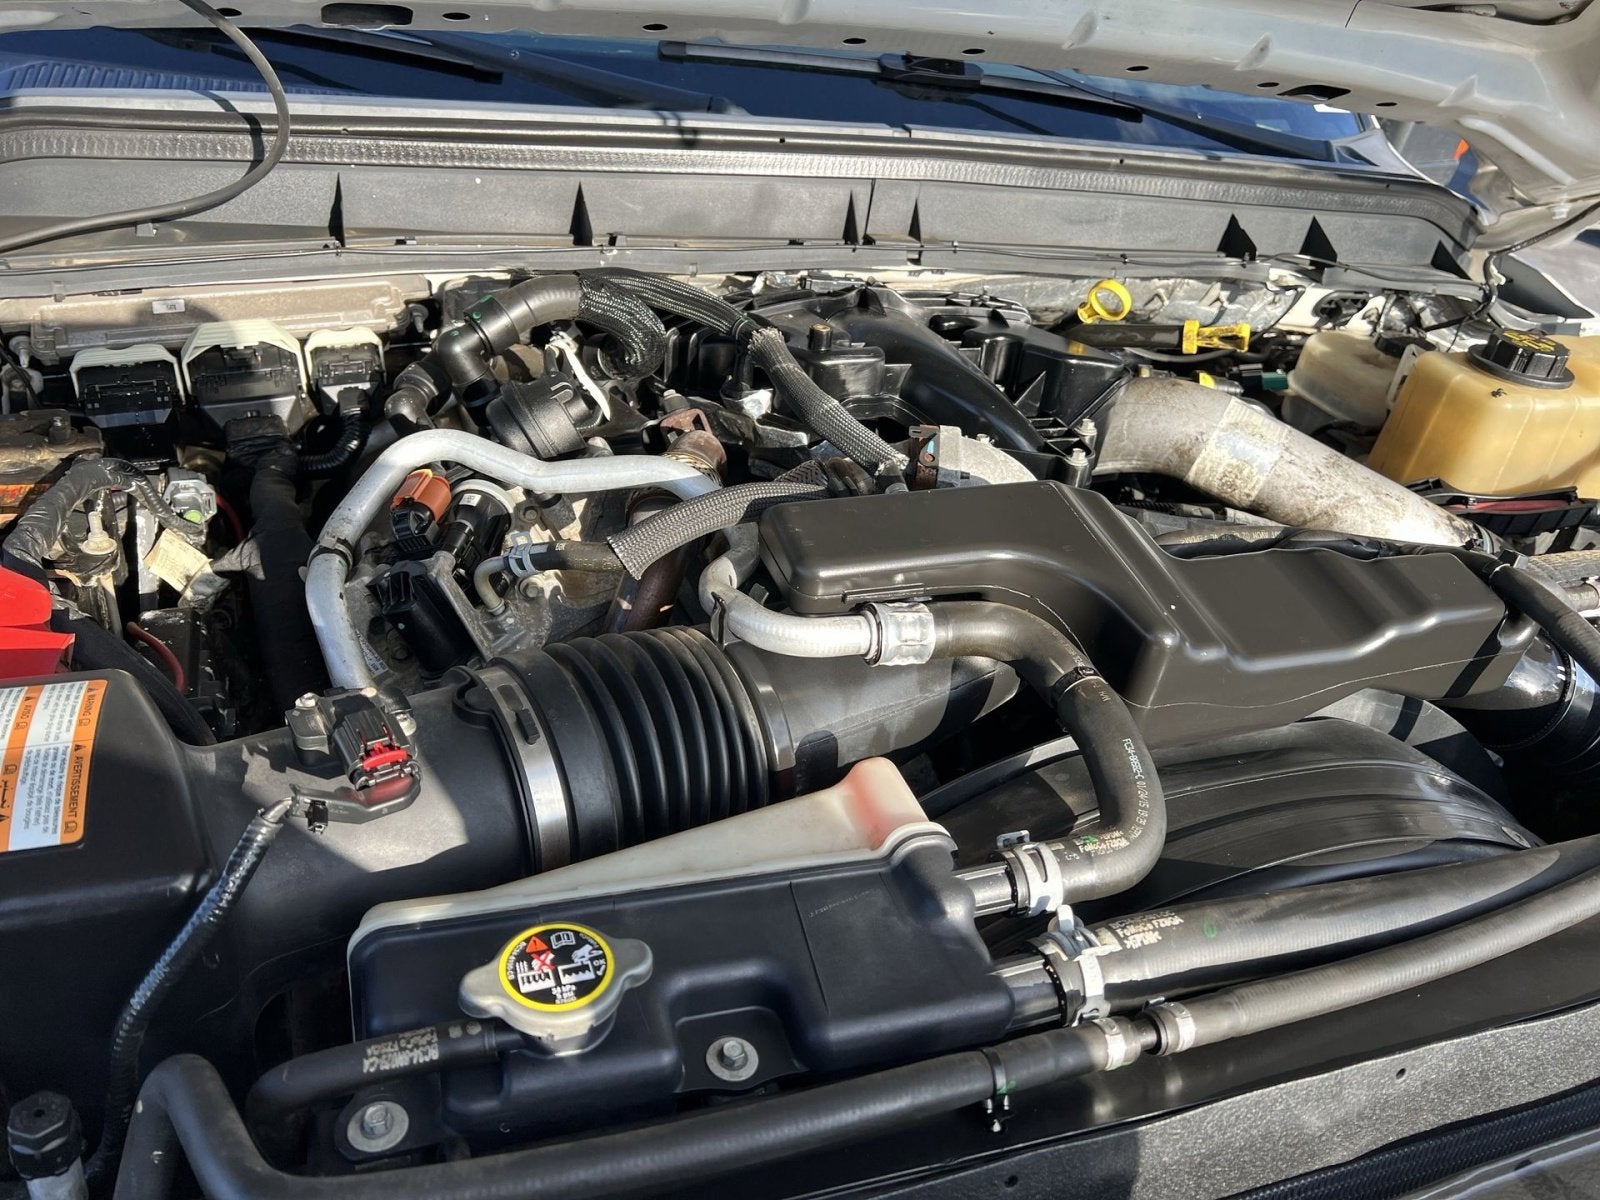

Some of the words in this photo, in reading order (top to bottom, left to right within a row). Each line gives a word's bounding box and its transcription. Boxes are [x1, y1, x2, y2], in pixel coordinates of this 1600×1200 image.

[82, 693, 96, 717] WARNING
[68, 756, 84, 818] AVERTISSEMENT
[593, 959, 606, 967] OK
